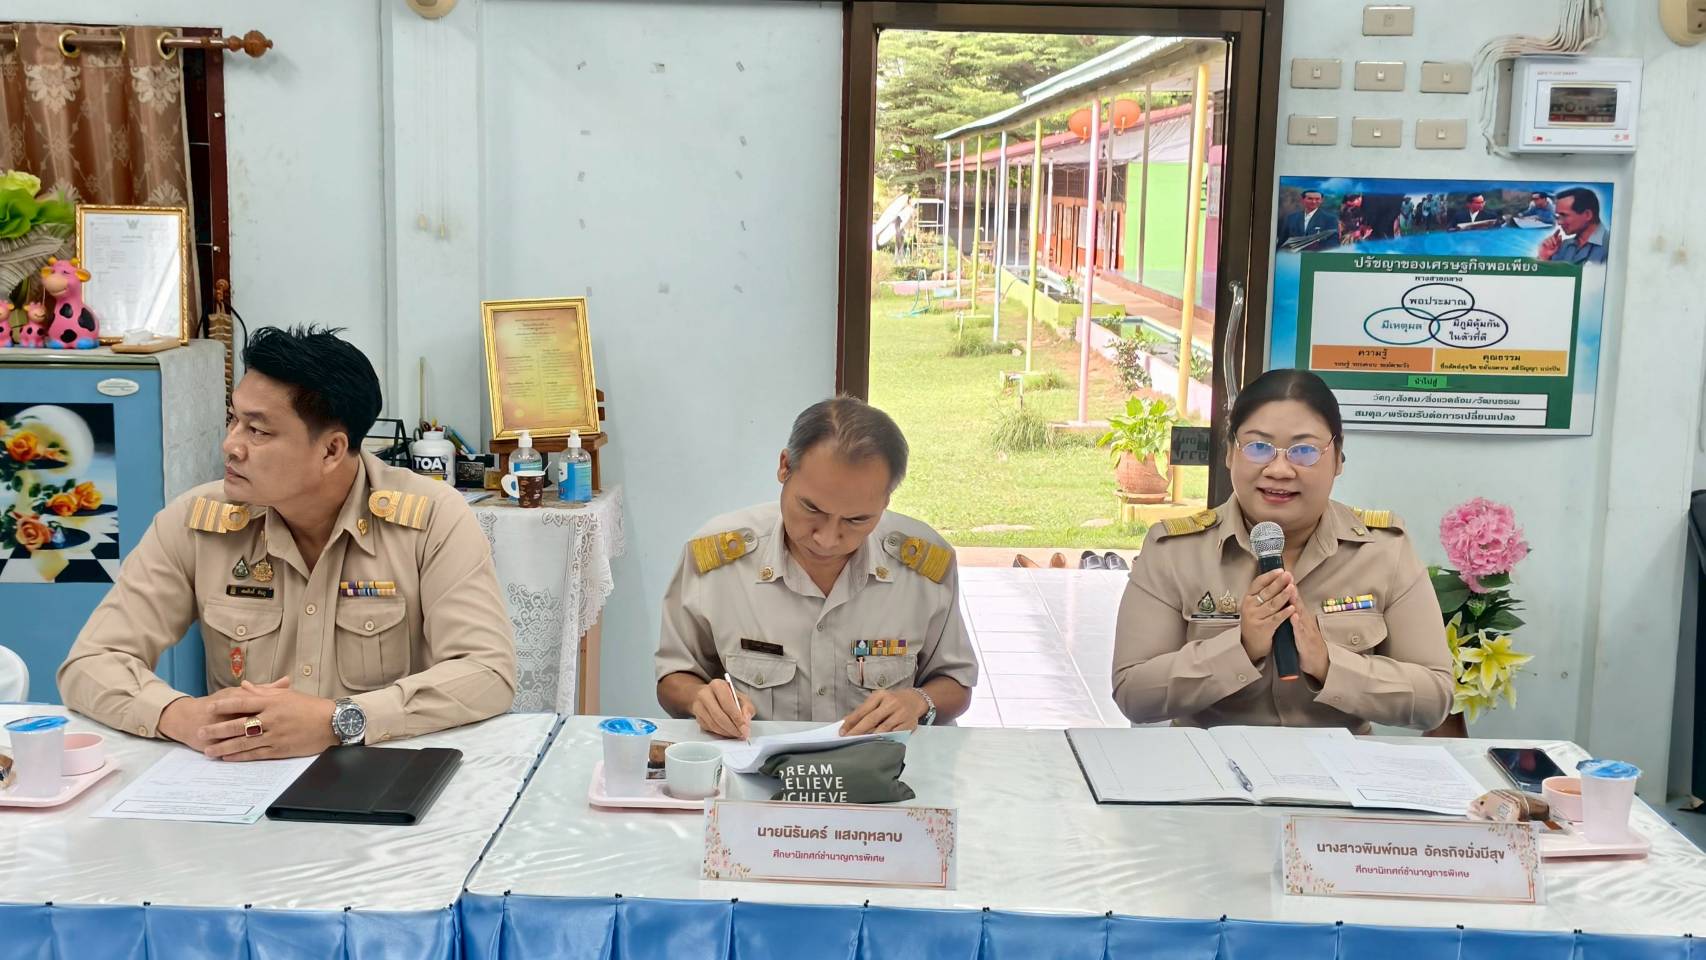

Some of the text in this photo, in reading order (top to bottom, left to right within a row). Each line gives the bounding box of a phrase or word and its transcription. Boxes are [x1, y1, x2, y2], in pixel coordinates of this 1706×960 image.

[1354, 257, 1538, 273] ปรัชญาของเศรษฐกิจพอเพียง
[1409, 297, 1467, 306] พอประมาณ
[1381, 320, 1423, 332] มีเหตุผล
[1453, 319, 1501, 330] มีภูมิคุ้มกัน
[1448, 331, 1488, 341] ในตัวที่ดี
[1358, 349, 1388, 360] ความรู้
[1482, 354, 1521, 363] คุณธรรม
[415, 457, 443, 470] TOA
[781, 777, 843, 790] ELIEVE
[758, 825, 902, 846] นายนิรันดร์ แสงกุหลาบ
[773, 849, 885, 862] ศึกษานิเทศก์ชำนาญการพิเศษ
[1317, 842, 1504, 863] นางสาวพิมพ์กมล อัครกิจมั่งมีสุข
[1355, 864, 1470, 878] ศึกษานิเทศก์ชำนาญการพิเศษ
